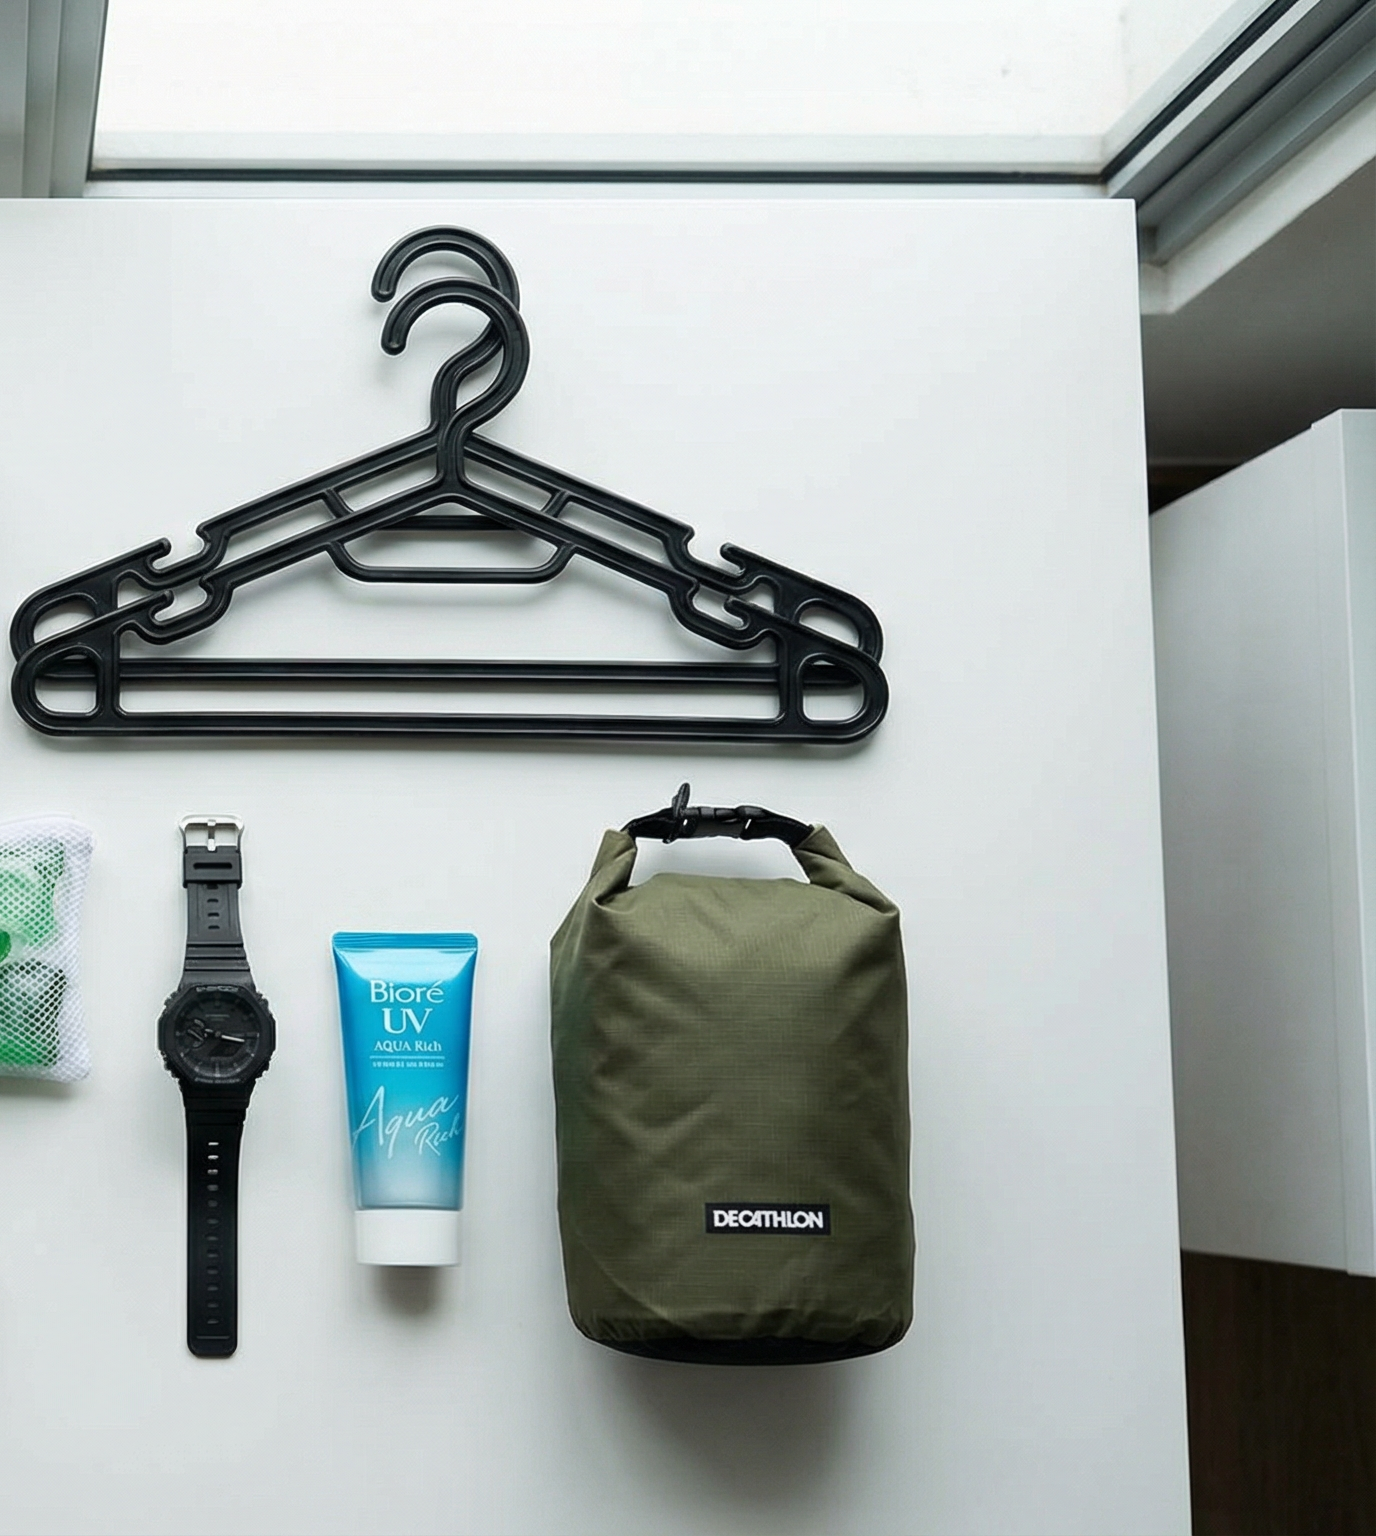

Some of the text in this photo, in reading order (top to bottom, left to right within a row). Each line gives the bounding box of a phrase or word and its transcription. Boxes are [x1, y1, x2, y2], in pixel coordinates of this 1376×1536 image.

[370, 979, 445, 1003] Bioré
[382, 1007, 433, 1034] UV
[374, 1040, 442, 1053] AQUA Rich
[352, 1085, 459, 1159] Aqua
[712, 1209, 824, 1229] DECATHLON
